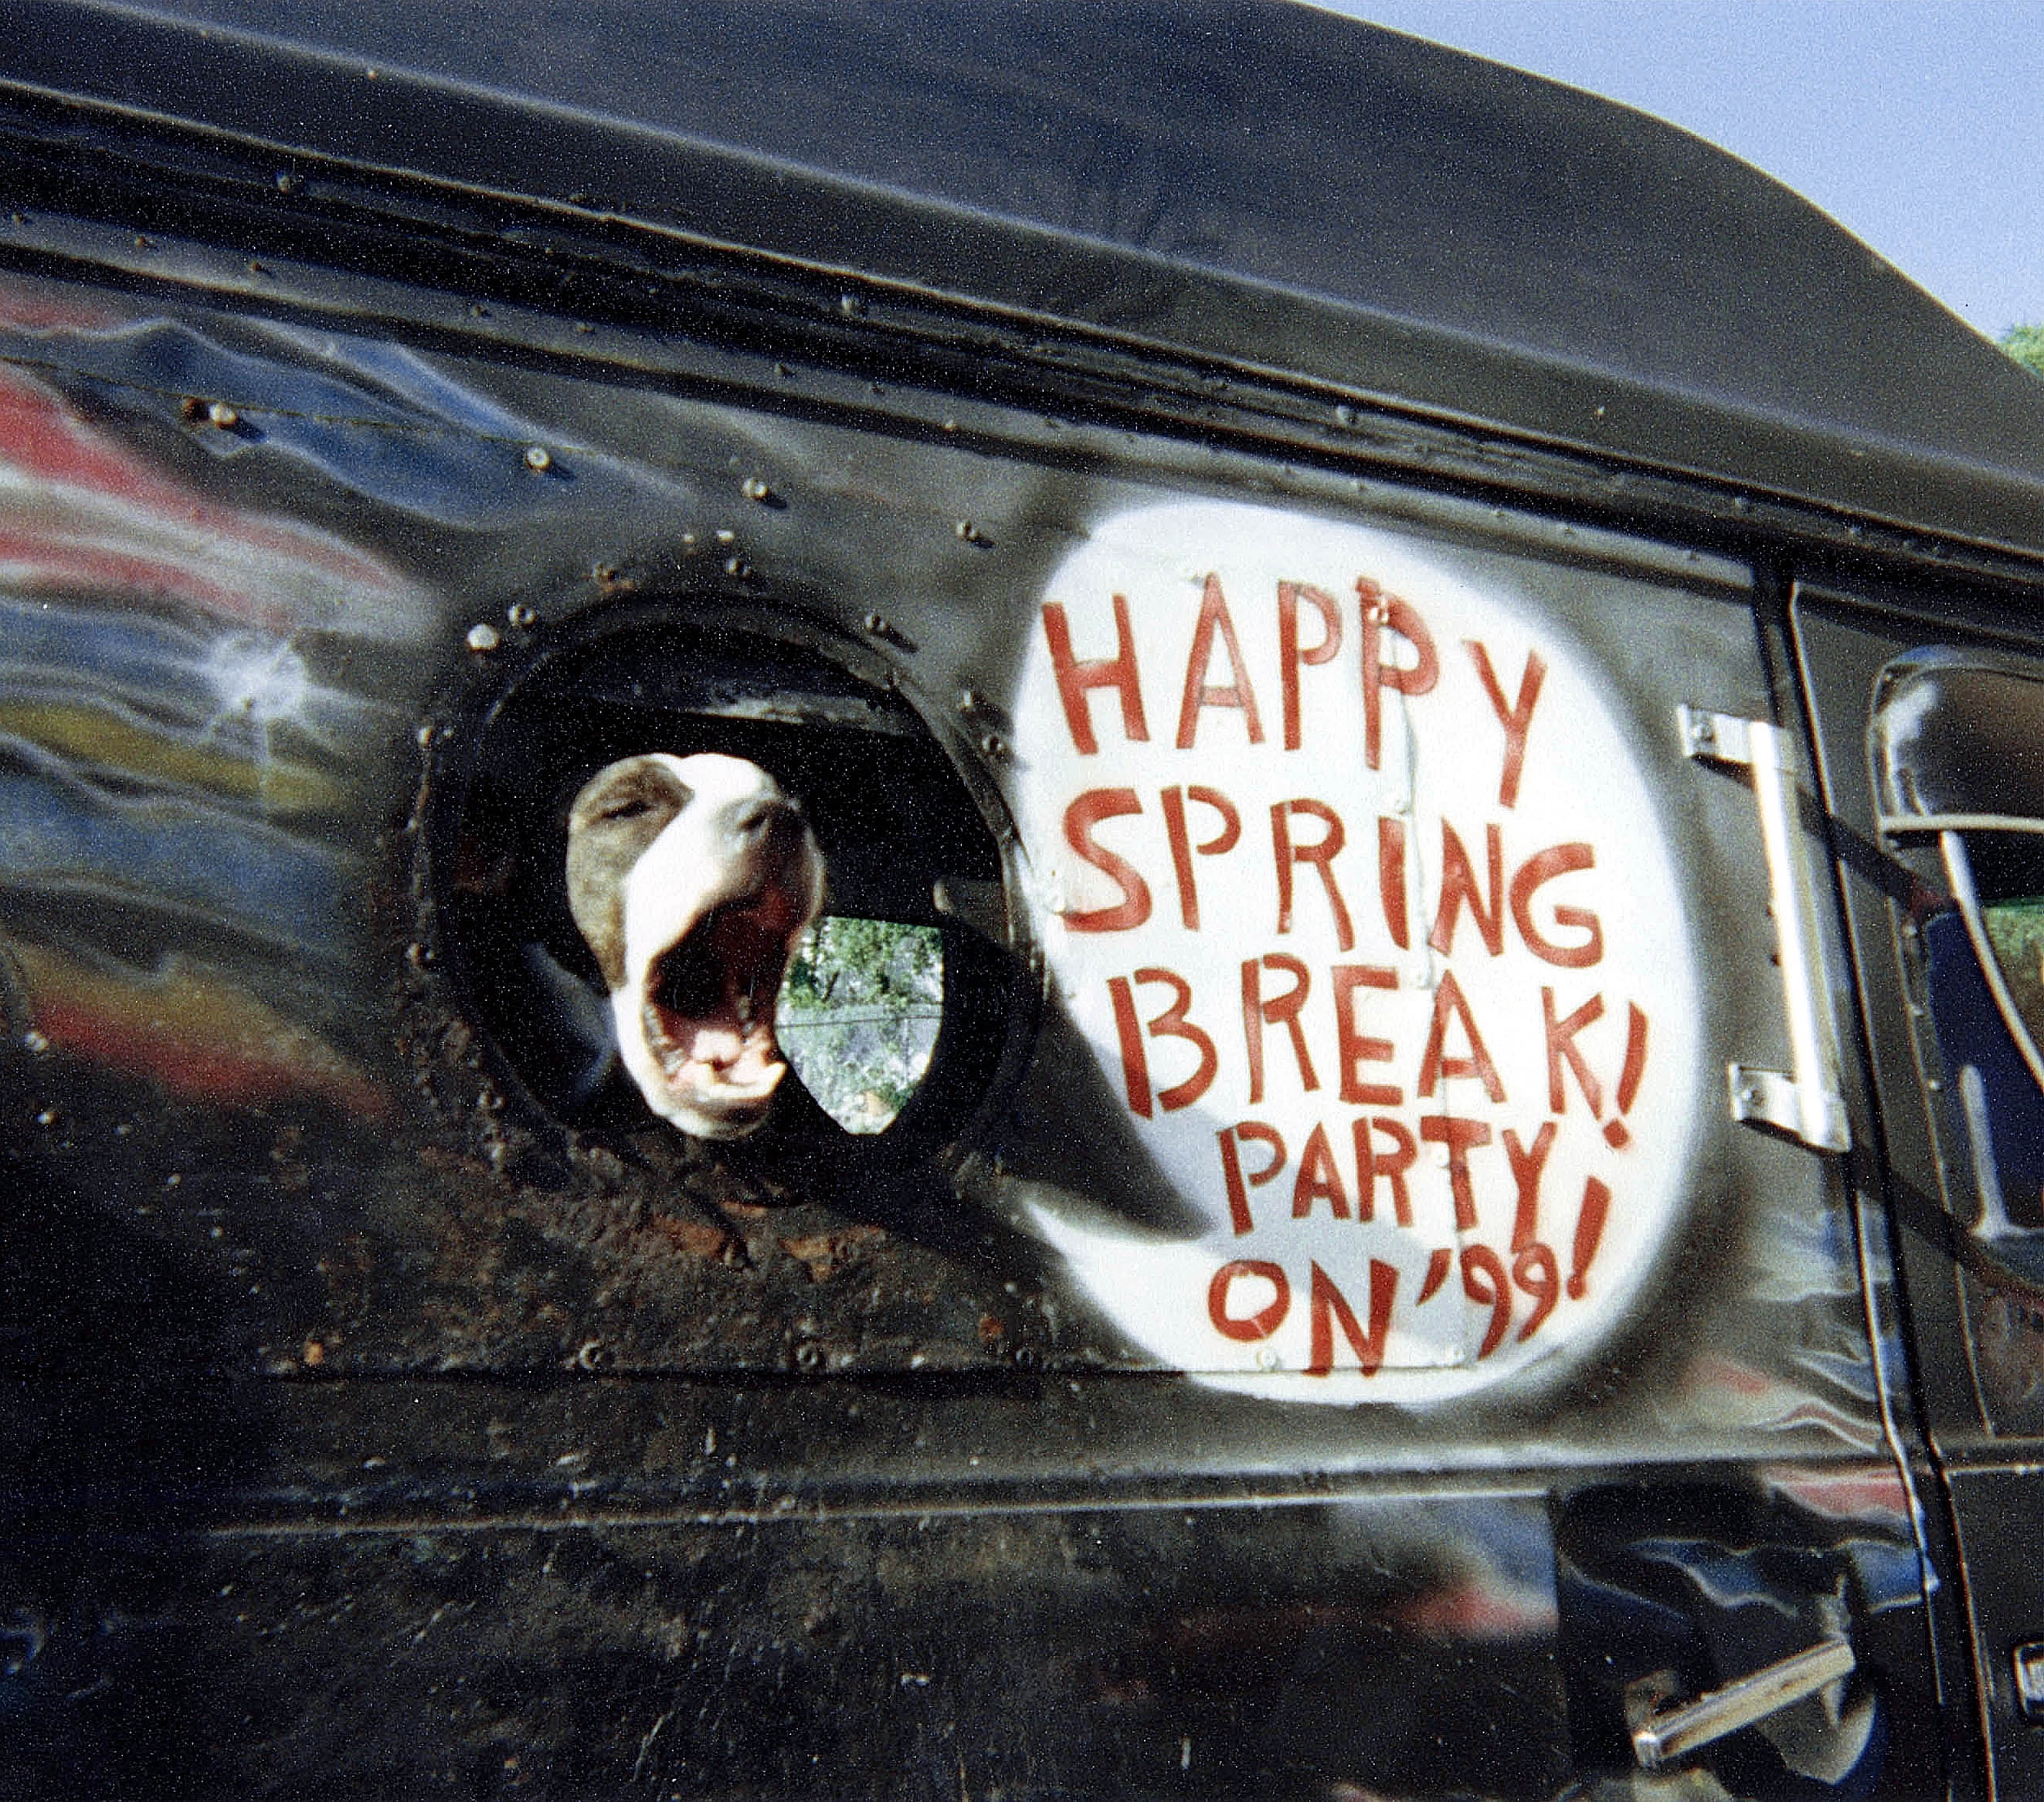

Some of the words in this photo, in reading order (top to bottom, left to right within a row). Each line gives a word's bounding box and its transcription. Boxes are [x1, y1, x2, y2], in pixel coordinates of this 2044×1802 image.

[1043, 572, 1546, 808] HAPPY
[1063, 784, 1604, 968] SPRING
[1108, 952, 1648, 1149] BREAK!
[1216, 1115, 1556, 1253] PARTY
[1207, 1259, 1398, 1377] ON
